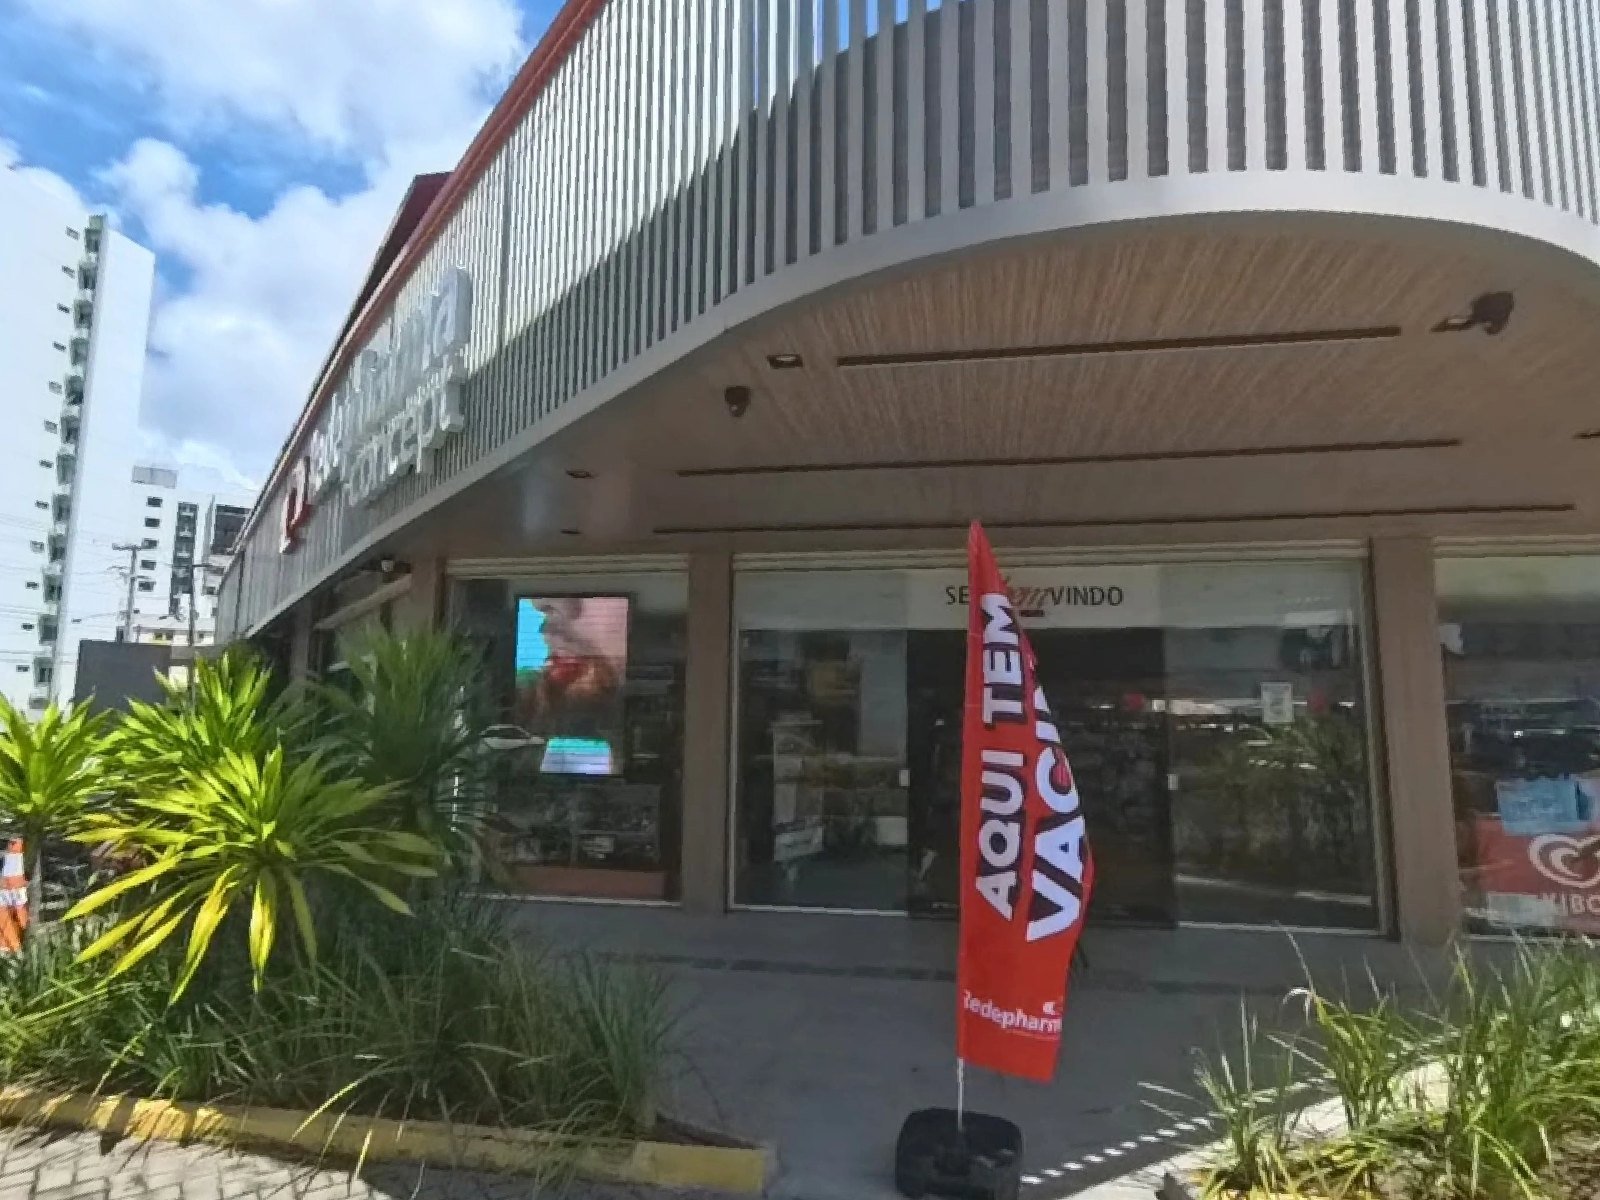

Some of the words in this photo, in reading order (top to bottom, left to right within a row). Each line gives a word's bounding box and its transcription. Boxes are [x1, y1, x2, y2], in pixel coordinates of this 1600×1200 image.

[981, 592, 1024, 724] TEM
[1048, 585, 1124, 607] VINDO
[975, 749, 1024, 921] AQUI
